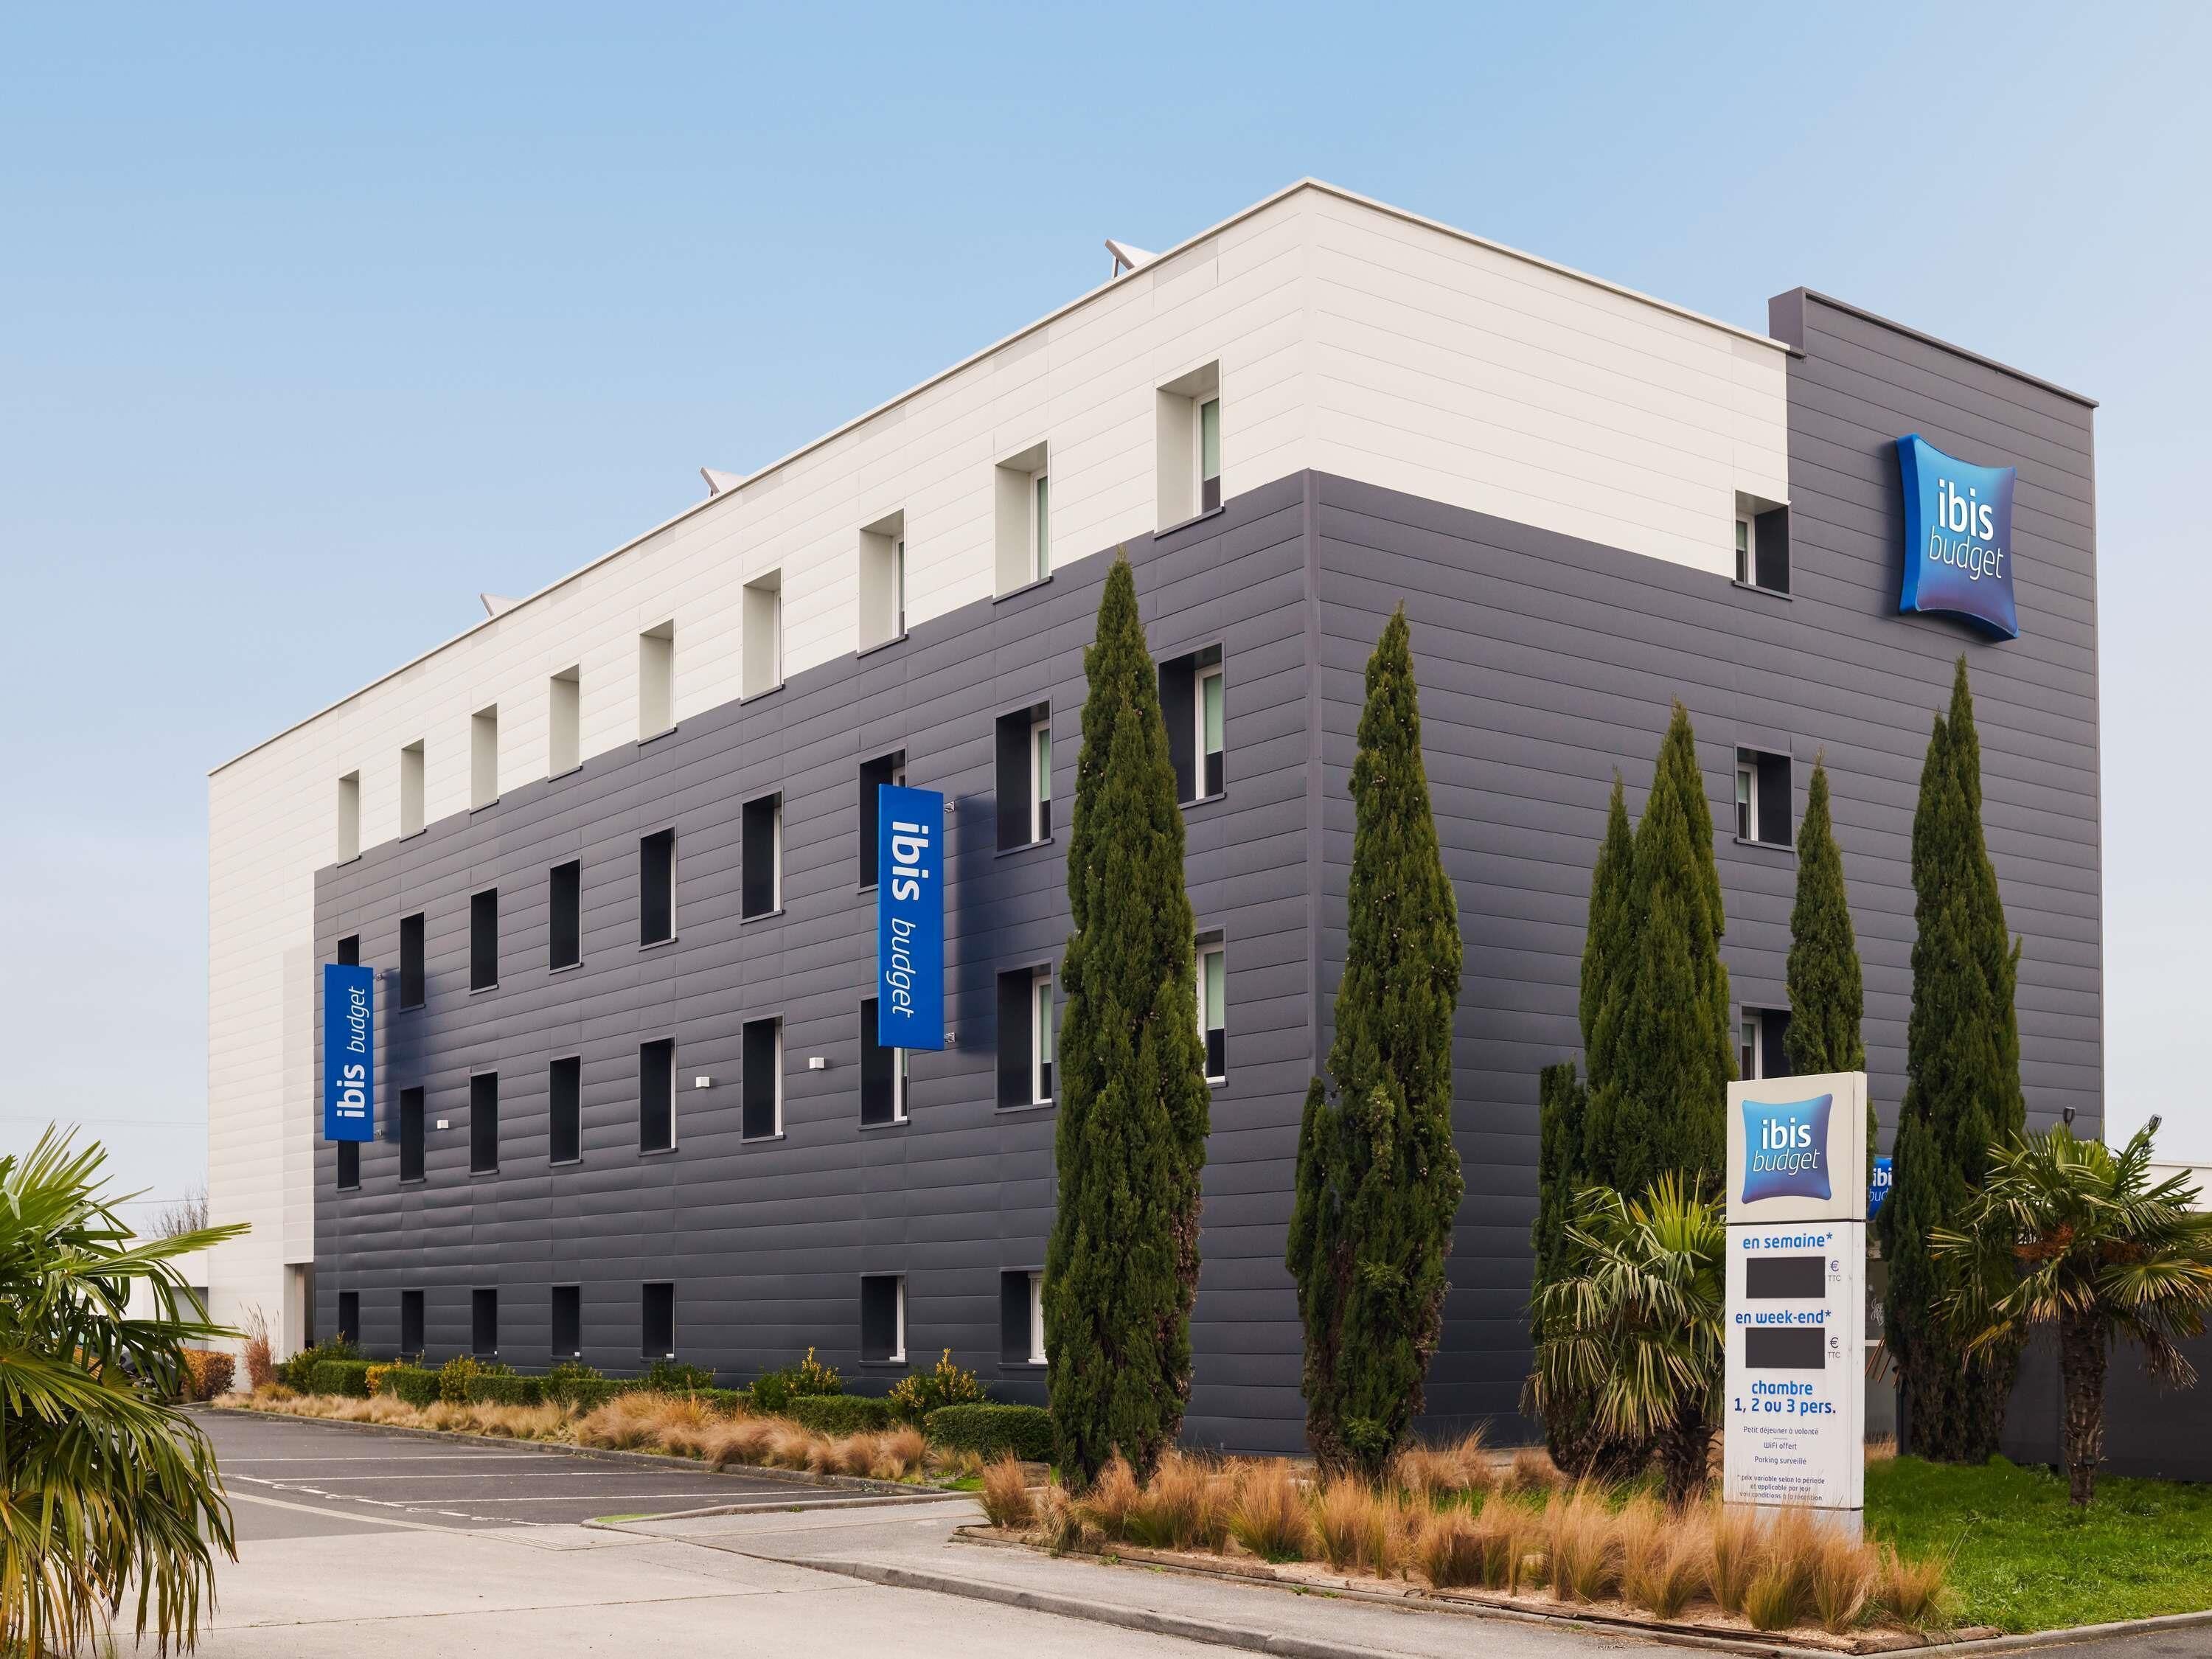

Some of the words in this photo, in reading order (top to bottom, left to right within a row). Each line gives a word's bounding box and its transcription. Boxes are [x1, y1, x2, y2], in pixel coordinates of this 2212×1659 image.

[1938, 479, 1994, 540] ibis
[1928, 525, 2004, 580] budget
[892, 821, 929, 901] ibis
[886, 917, 917, 1018] budget
[346, 985, 370, 1053] budget
[336, 1064, 366, 1118] ibis
[1761, 1117, 1812, 1150] ibis
[1753, 1148, 1820, 1176] budget
[1873, 1167, 1893, 1187] ibi
[1743, 1238, 1760, 1249] en
[1830, 1260, 1840, 1272] €
[1735, 1312, 1751, 1324] en
[1829, 1337, 1839, 1349] €
[1752, 1380, 1813, 1395] chambre
[1734, 1397, 1746, 1413] 1,
[1751, 1398, 1759, 1412] 2
[1764, 1401, 1781, 1413] ou
[1787, 1399, 1795, 1413] 3
[1800, 1402, 1836, 1416] pers.
[1760, 1426, 1787, 1435] déjeuner
[1779, 1442, 1797, 1450] offert
[1754, 1455, 1778, 1465] Parking
[1780, 1457, 1806, 1465] surveillé
